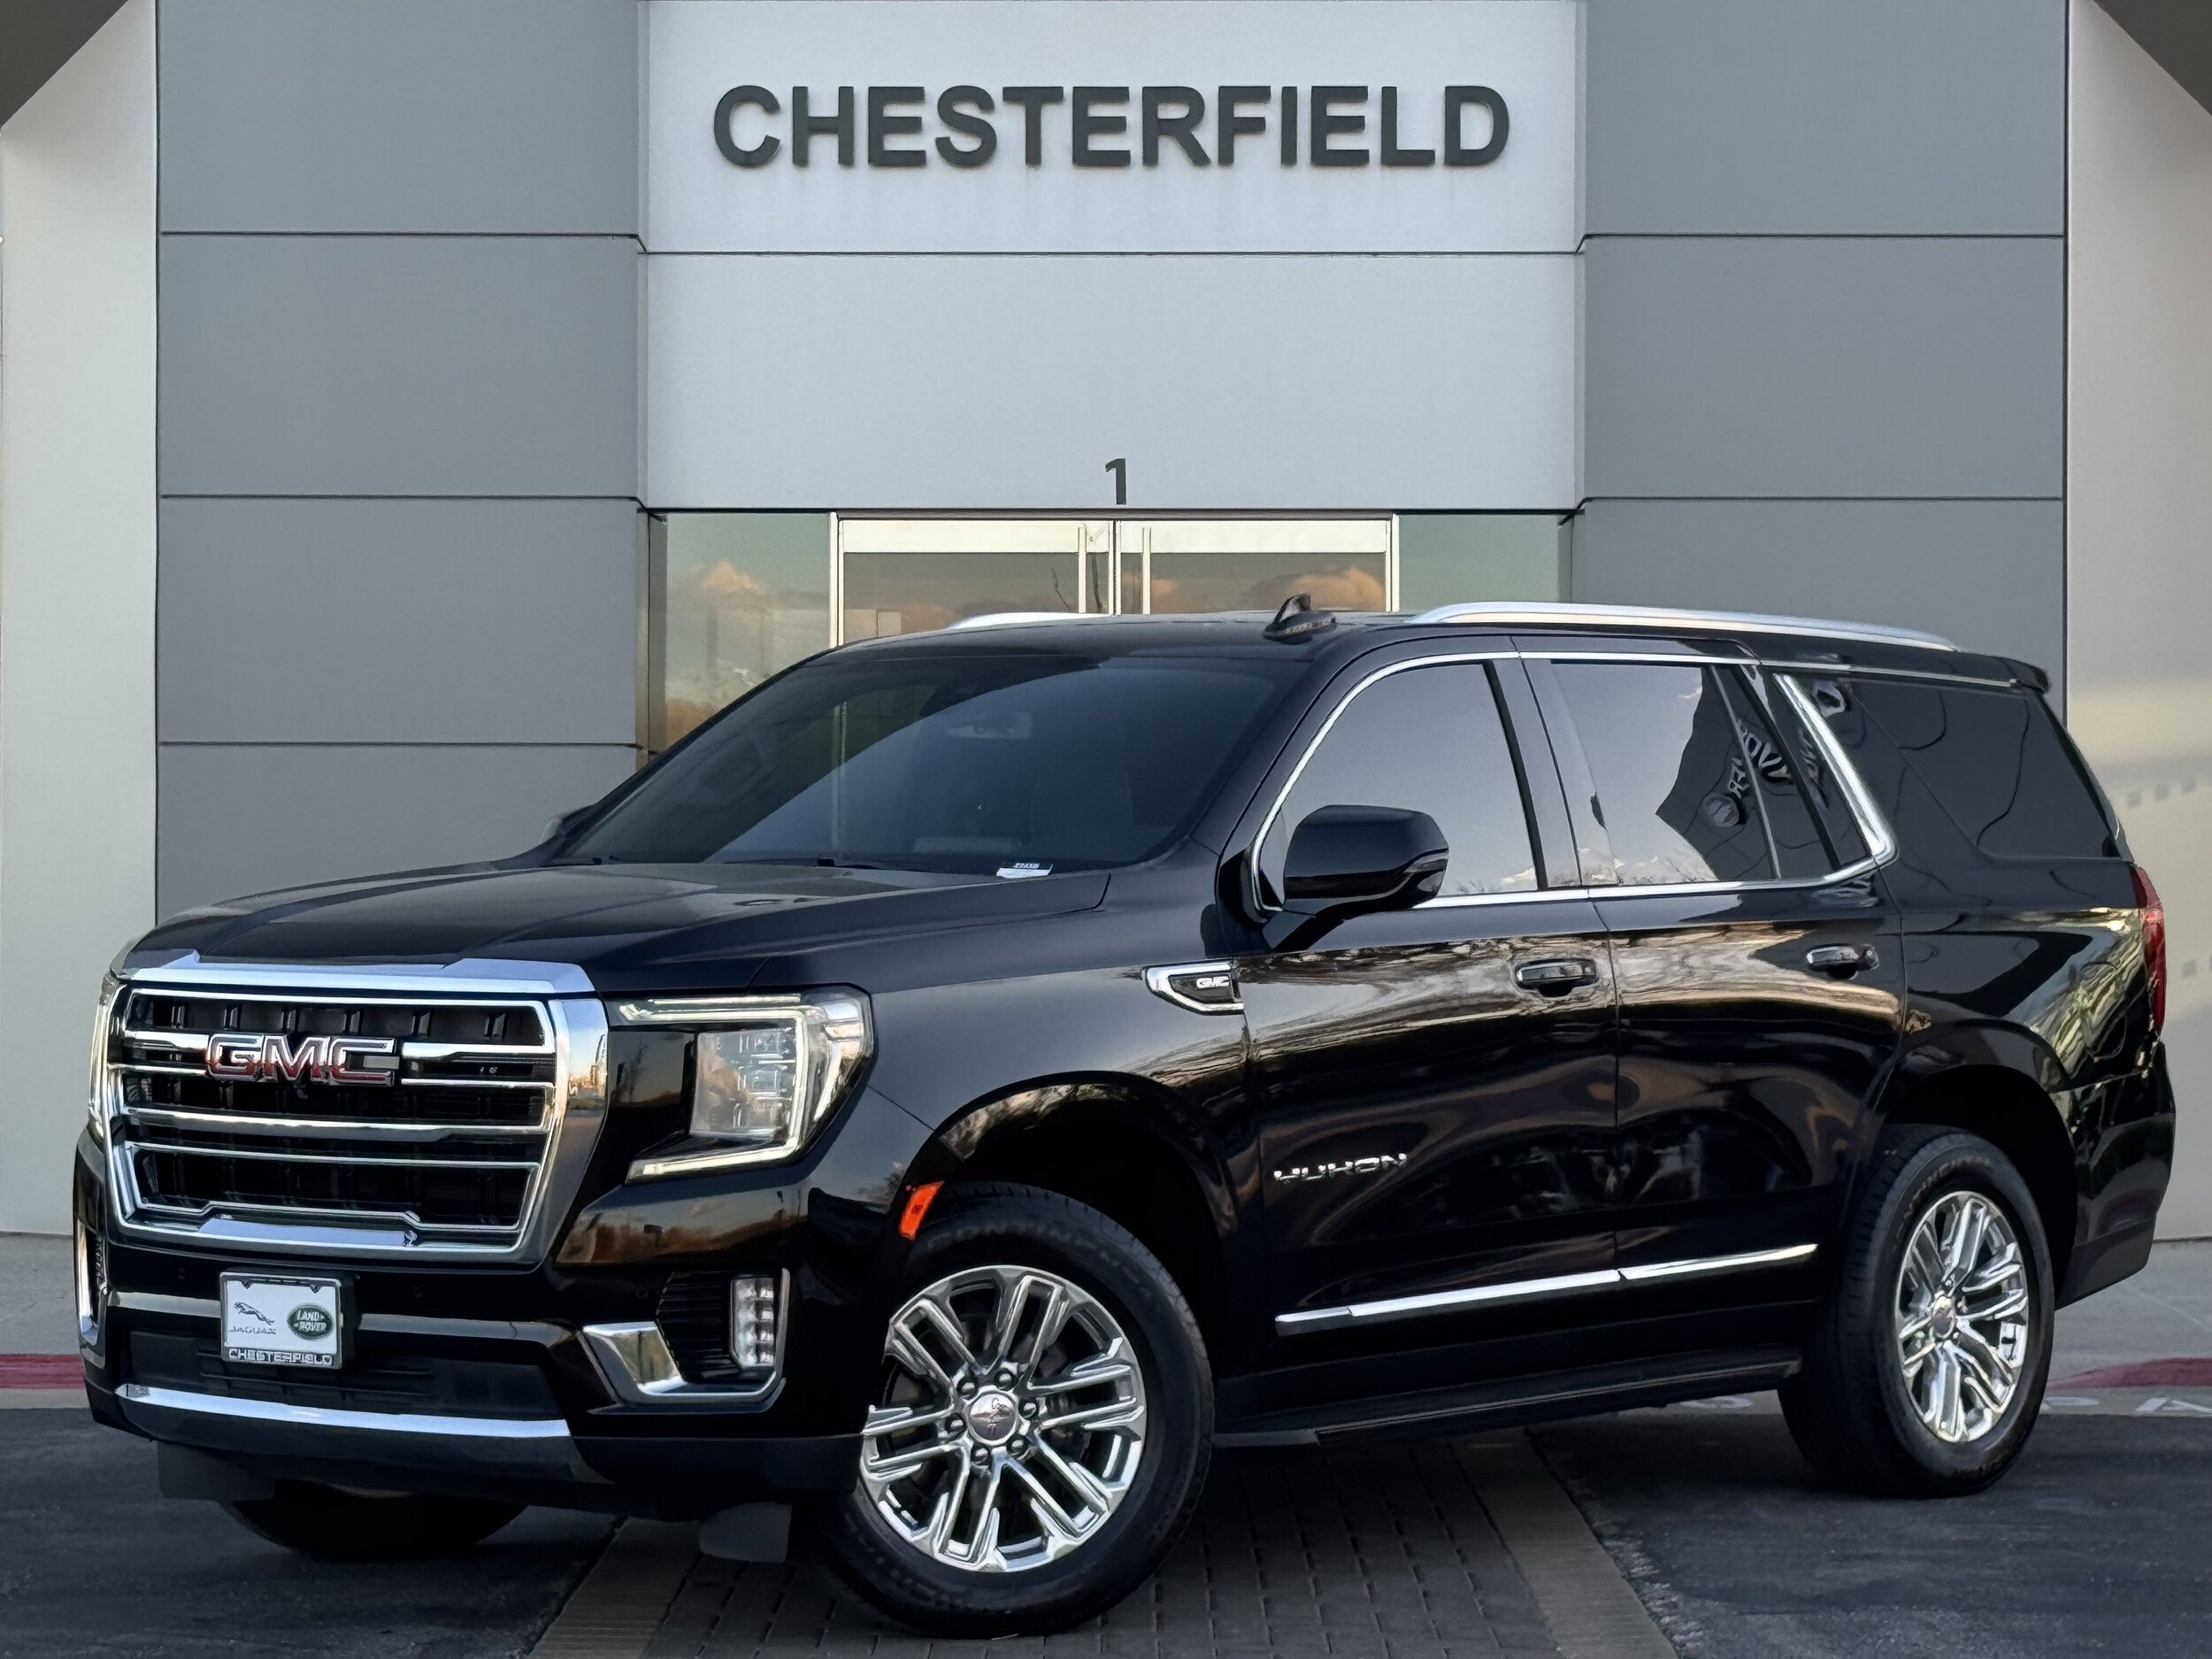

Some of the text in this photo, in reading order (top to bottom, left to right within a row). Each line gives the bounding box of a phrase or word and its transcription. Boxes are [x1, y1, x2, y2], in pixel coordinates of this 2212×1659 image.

[713, 85, 1510, 167] CHESTERFIELD
[1104, 457, 1128, 505] 1
[1196, 976, 1230, 989] GMC
[205, 1033, 396, 1087] GMC
[1273, 1153, 1408, 1182] YUKON
[297, 1309, 320, 1322] LAND
